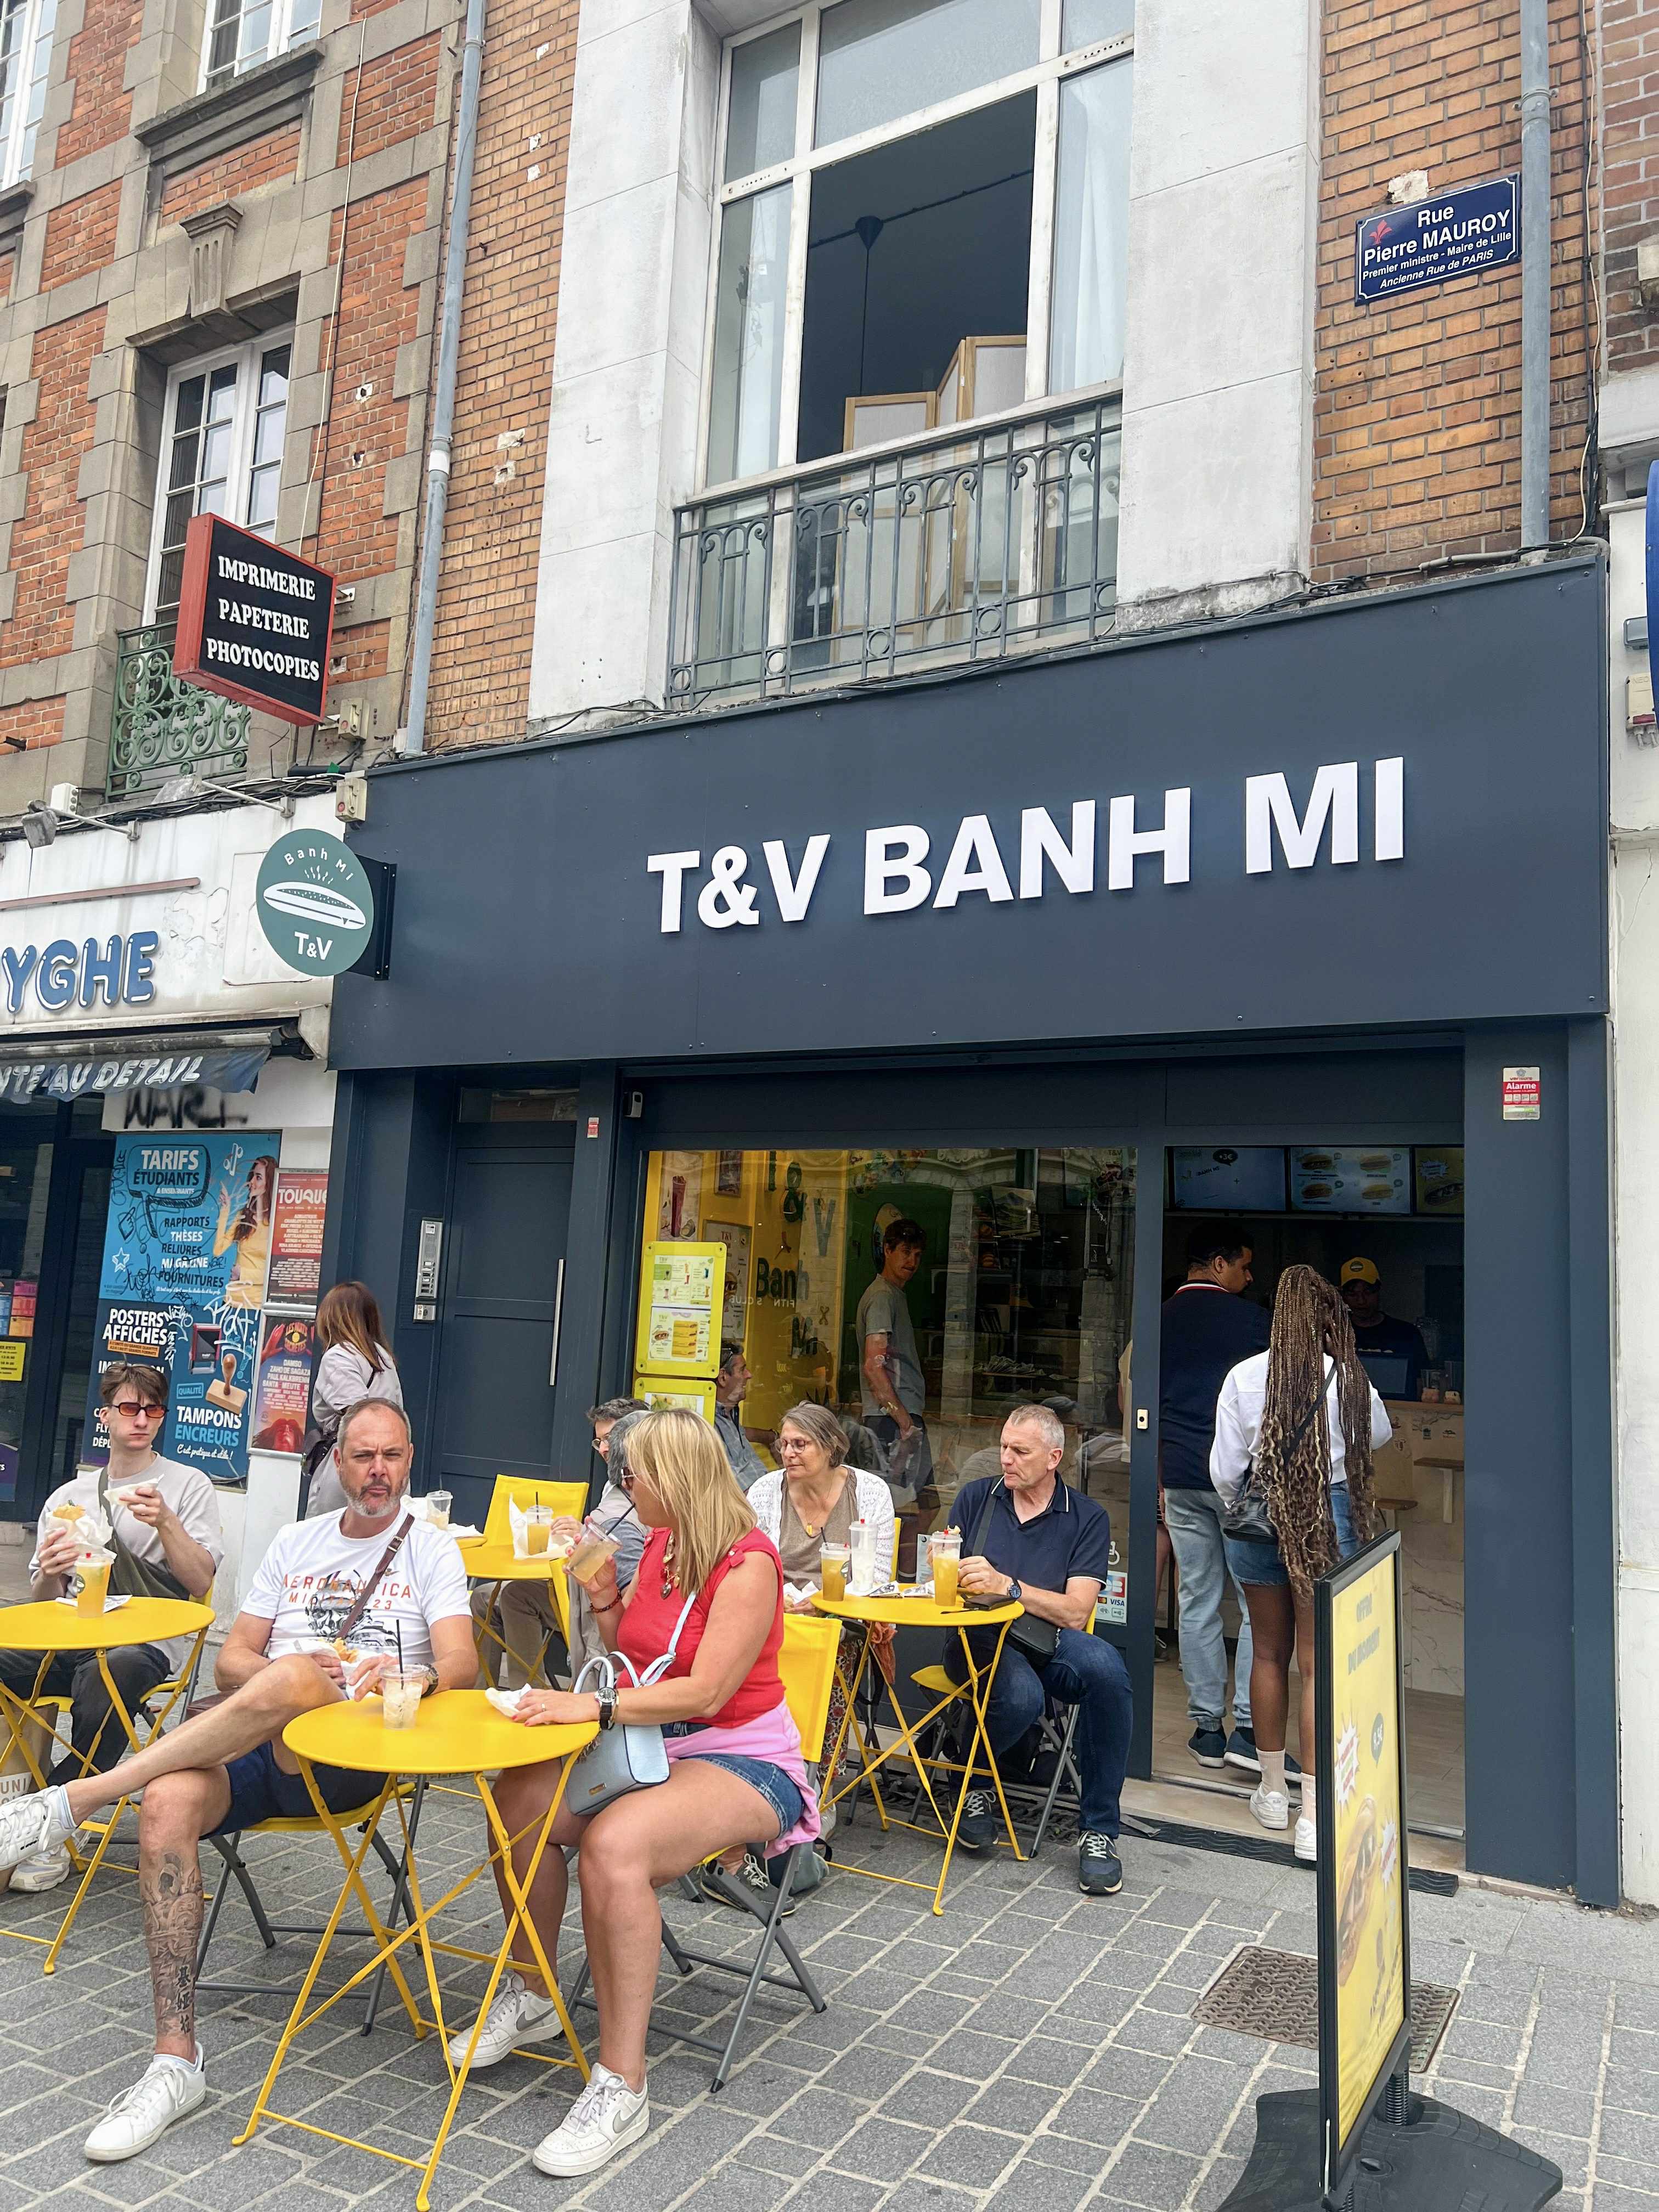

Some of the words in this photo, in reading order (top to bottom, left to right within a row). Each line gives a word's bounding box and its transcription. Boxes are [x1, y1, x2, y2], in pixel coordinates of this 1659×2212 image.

[1418, 206, 1454, 228] Rue
[1364, 239, 1417, 266] Pierre
[1423, 209, 1510, 250] MAUROY
[1363, 263, 1398, 280] Premier
[1401, 251, 1438, 270] ministre
[1447, 243, 1474, 256] Maire
[1476, 238, 1488, 248] de
[1491, 232, 1511, 245] Lille
[1379, 271, 1424, 289] Ancienne
[1426, 264, 1446, 276] Rue
[1447, 259, 1460, 270] de
[1462, 249, 1494, 266] PARIS
[218, 556, 315, 601] IMPRIMERIE
[218, 598, 309, 640] PAPETERIE
[206, 637, 320, 682] PHOTOCOPIES
[646, 833, 831, 933] T&V
[864, 787, 1191, 916] BANH
[1245, 756, 1404, 874] MI
[284, 848, 328, 865] Banh
[294, 932, 334, 961] T&V
[1, 931, 159, 1014] YGHE
[48, 1063, 93, 1093] AU
[92, 1056, 203, 1091] DETAIL
[141, 1149, 199, 1170] TARIFS
[133, 1168, 200, 1186] ÉTUDIANTS
[164, 1216, 210, 1228] RAPPORTS
[171, 1230, 203, 1243] THÈSES
[161, 1243, 202, 1256] RELIURES
[158, 1270, 224, 1288] FOURNITURES
[109, 1308, 164, 1328] POSTERS
[103, 1324, 168, 1345] AFFICHES
[178, 1385, 202, 1396] QUALITÉ
[176, 1405, 242, 1430] TAMPONS
[175, 1424, 240, 1448] ENCREURS
[1110, 1598, 1125, 1607] VISA
[0, 1778, 26, 1795] UNI
